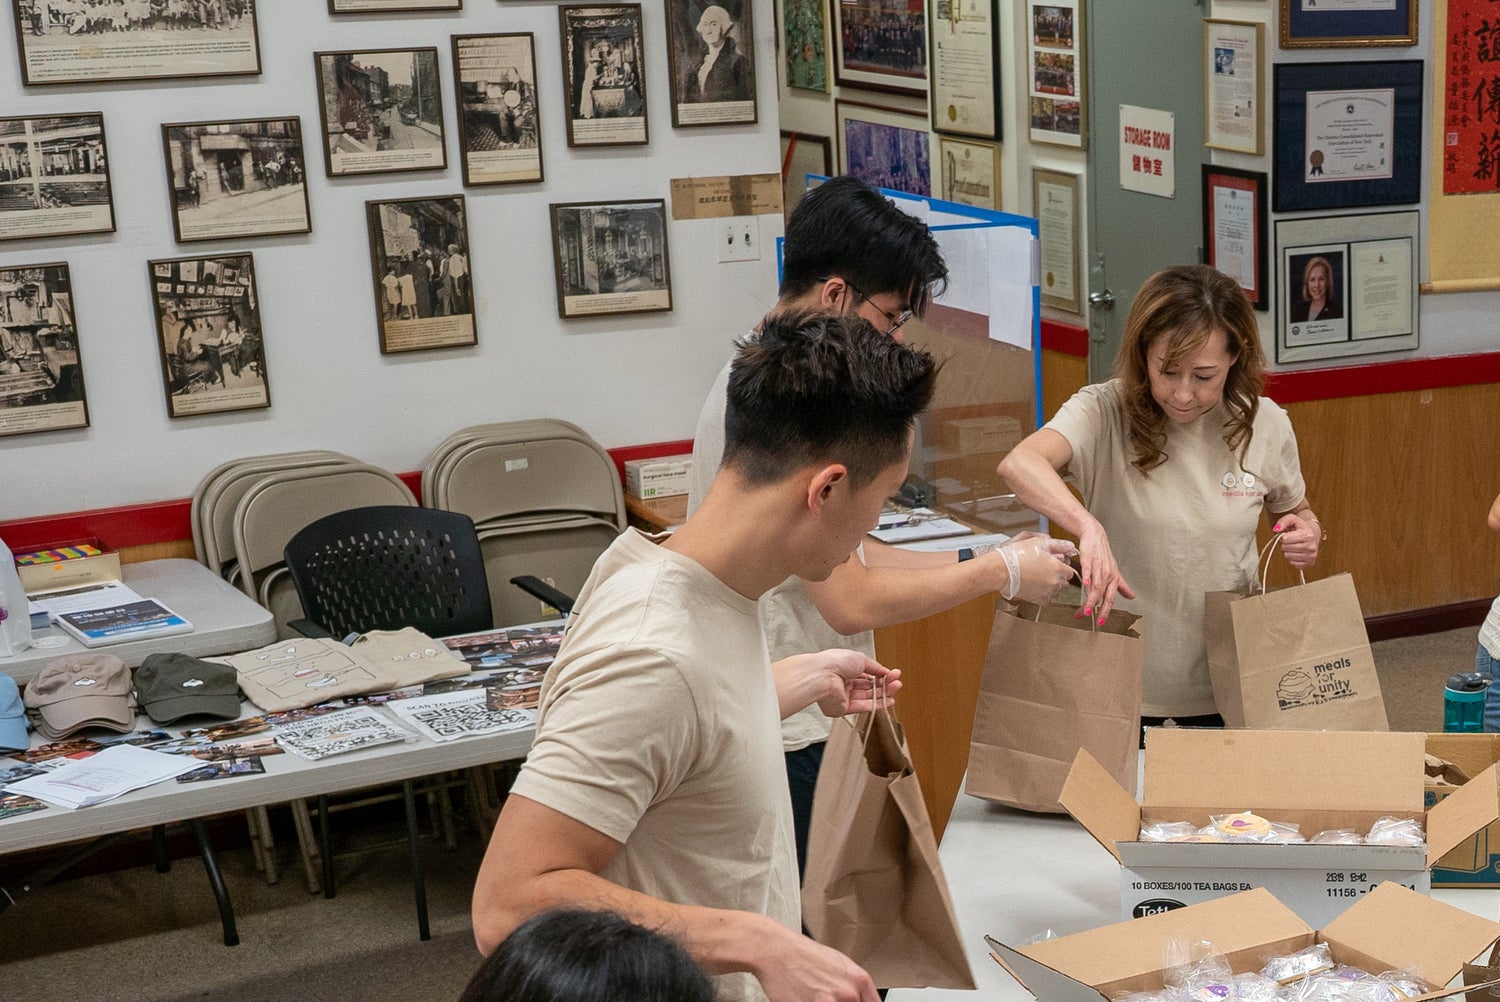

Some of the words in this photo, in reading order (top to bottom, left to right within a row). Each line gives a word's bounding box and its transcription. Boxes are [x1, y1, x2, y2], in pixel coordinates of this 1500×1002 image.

[1124, 126, 1152, 148] STORAGE
[1153, 130, 1171, 151] ROOM
[1132, 154, 1153, 176] 儲物室
[1314, 657, 1352, 674] meals
[1318, 680, 1352, 694] unity
[1131, 882, 1142, 891] 10
[1143, 882, 1192, 891] BOXES/100
[1193, 883, 1212, 891] TEA
[1213, 882, 1238, 891] BAGS
[1326, 888, 1357, 898] 11156
